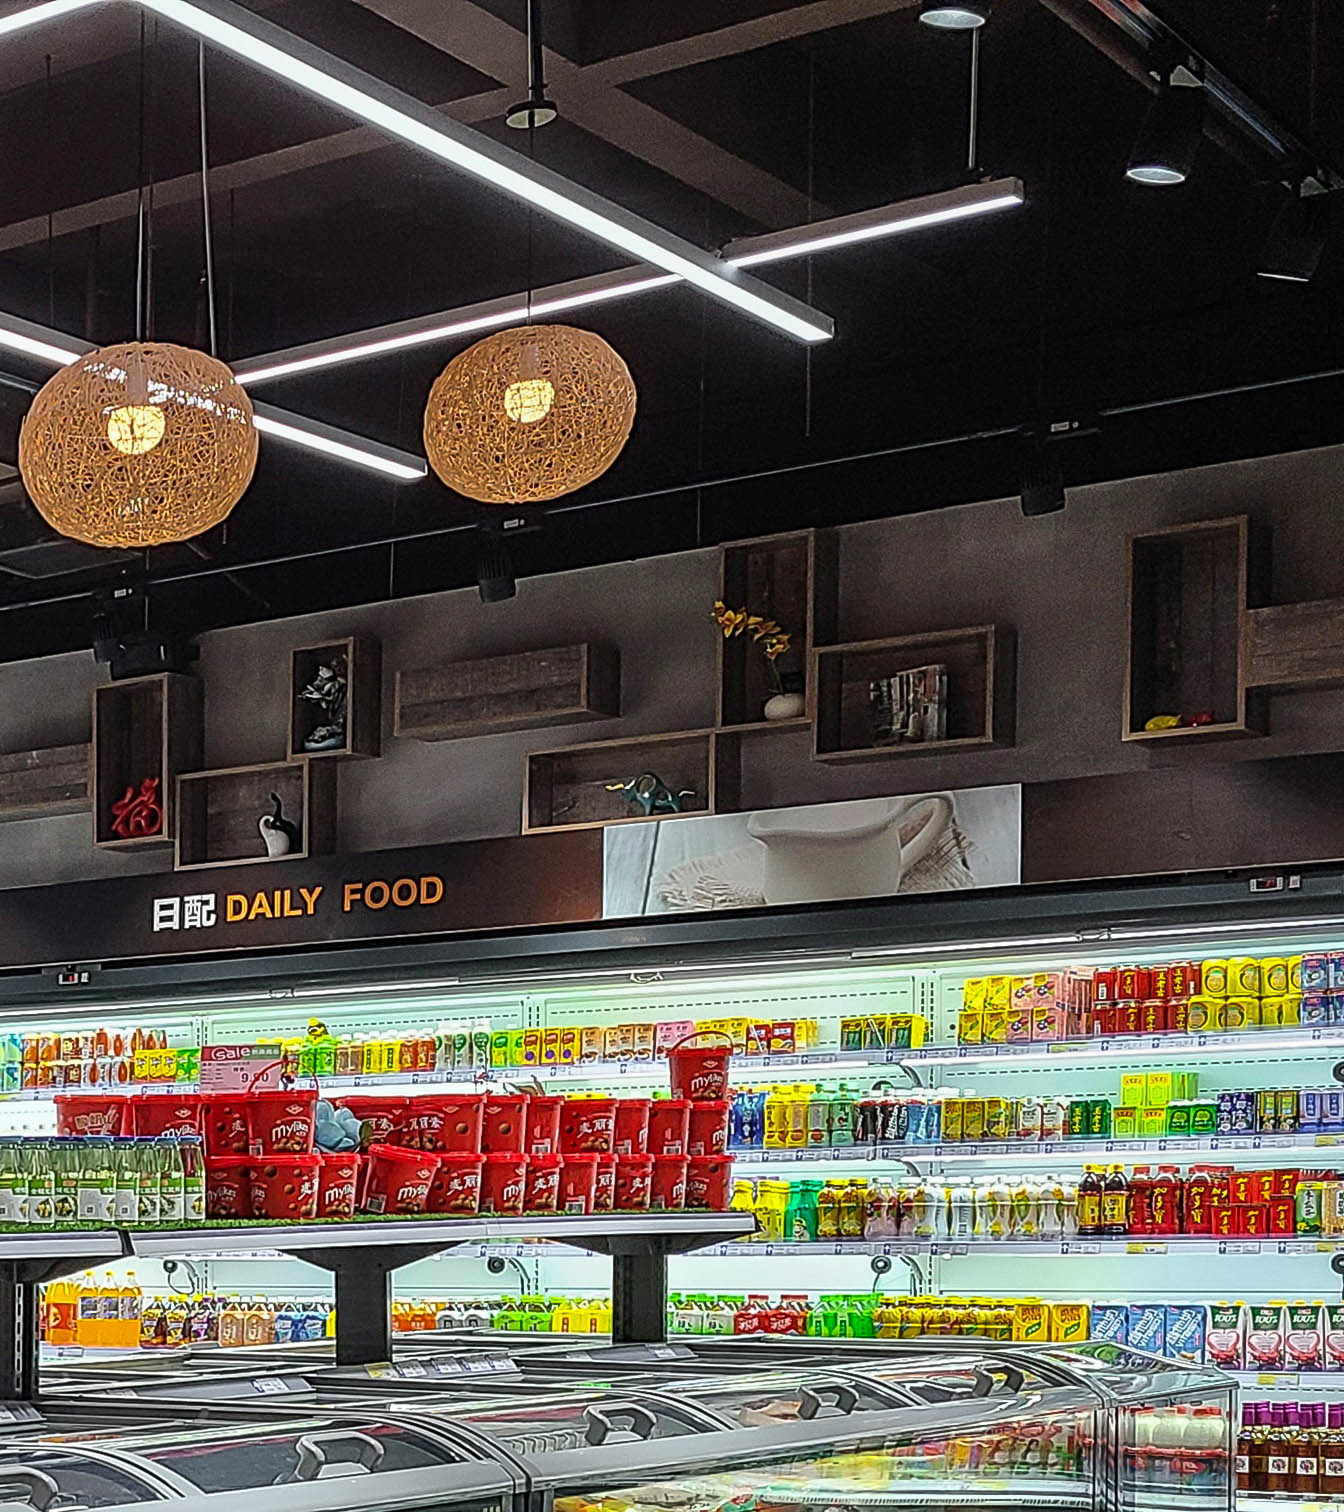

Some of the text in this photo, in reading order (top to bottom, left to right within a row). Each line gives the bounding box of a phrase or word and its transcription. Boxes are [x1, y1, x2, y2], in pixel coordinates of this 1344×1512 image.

[153, 876, 444, 932] 日配 DAILY FOOD
